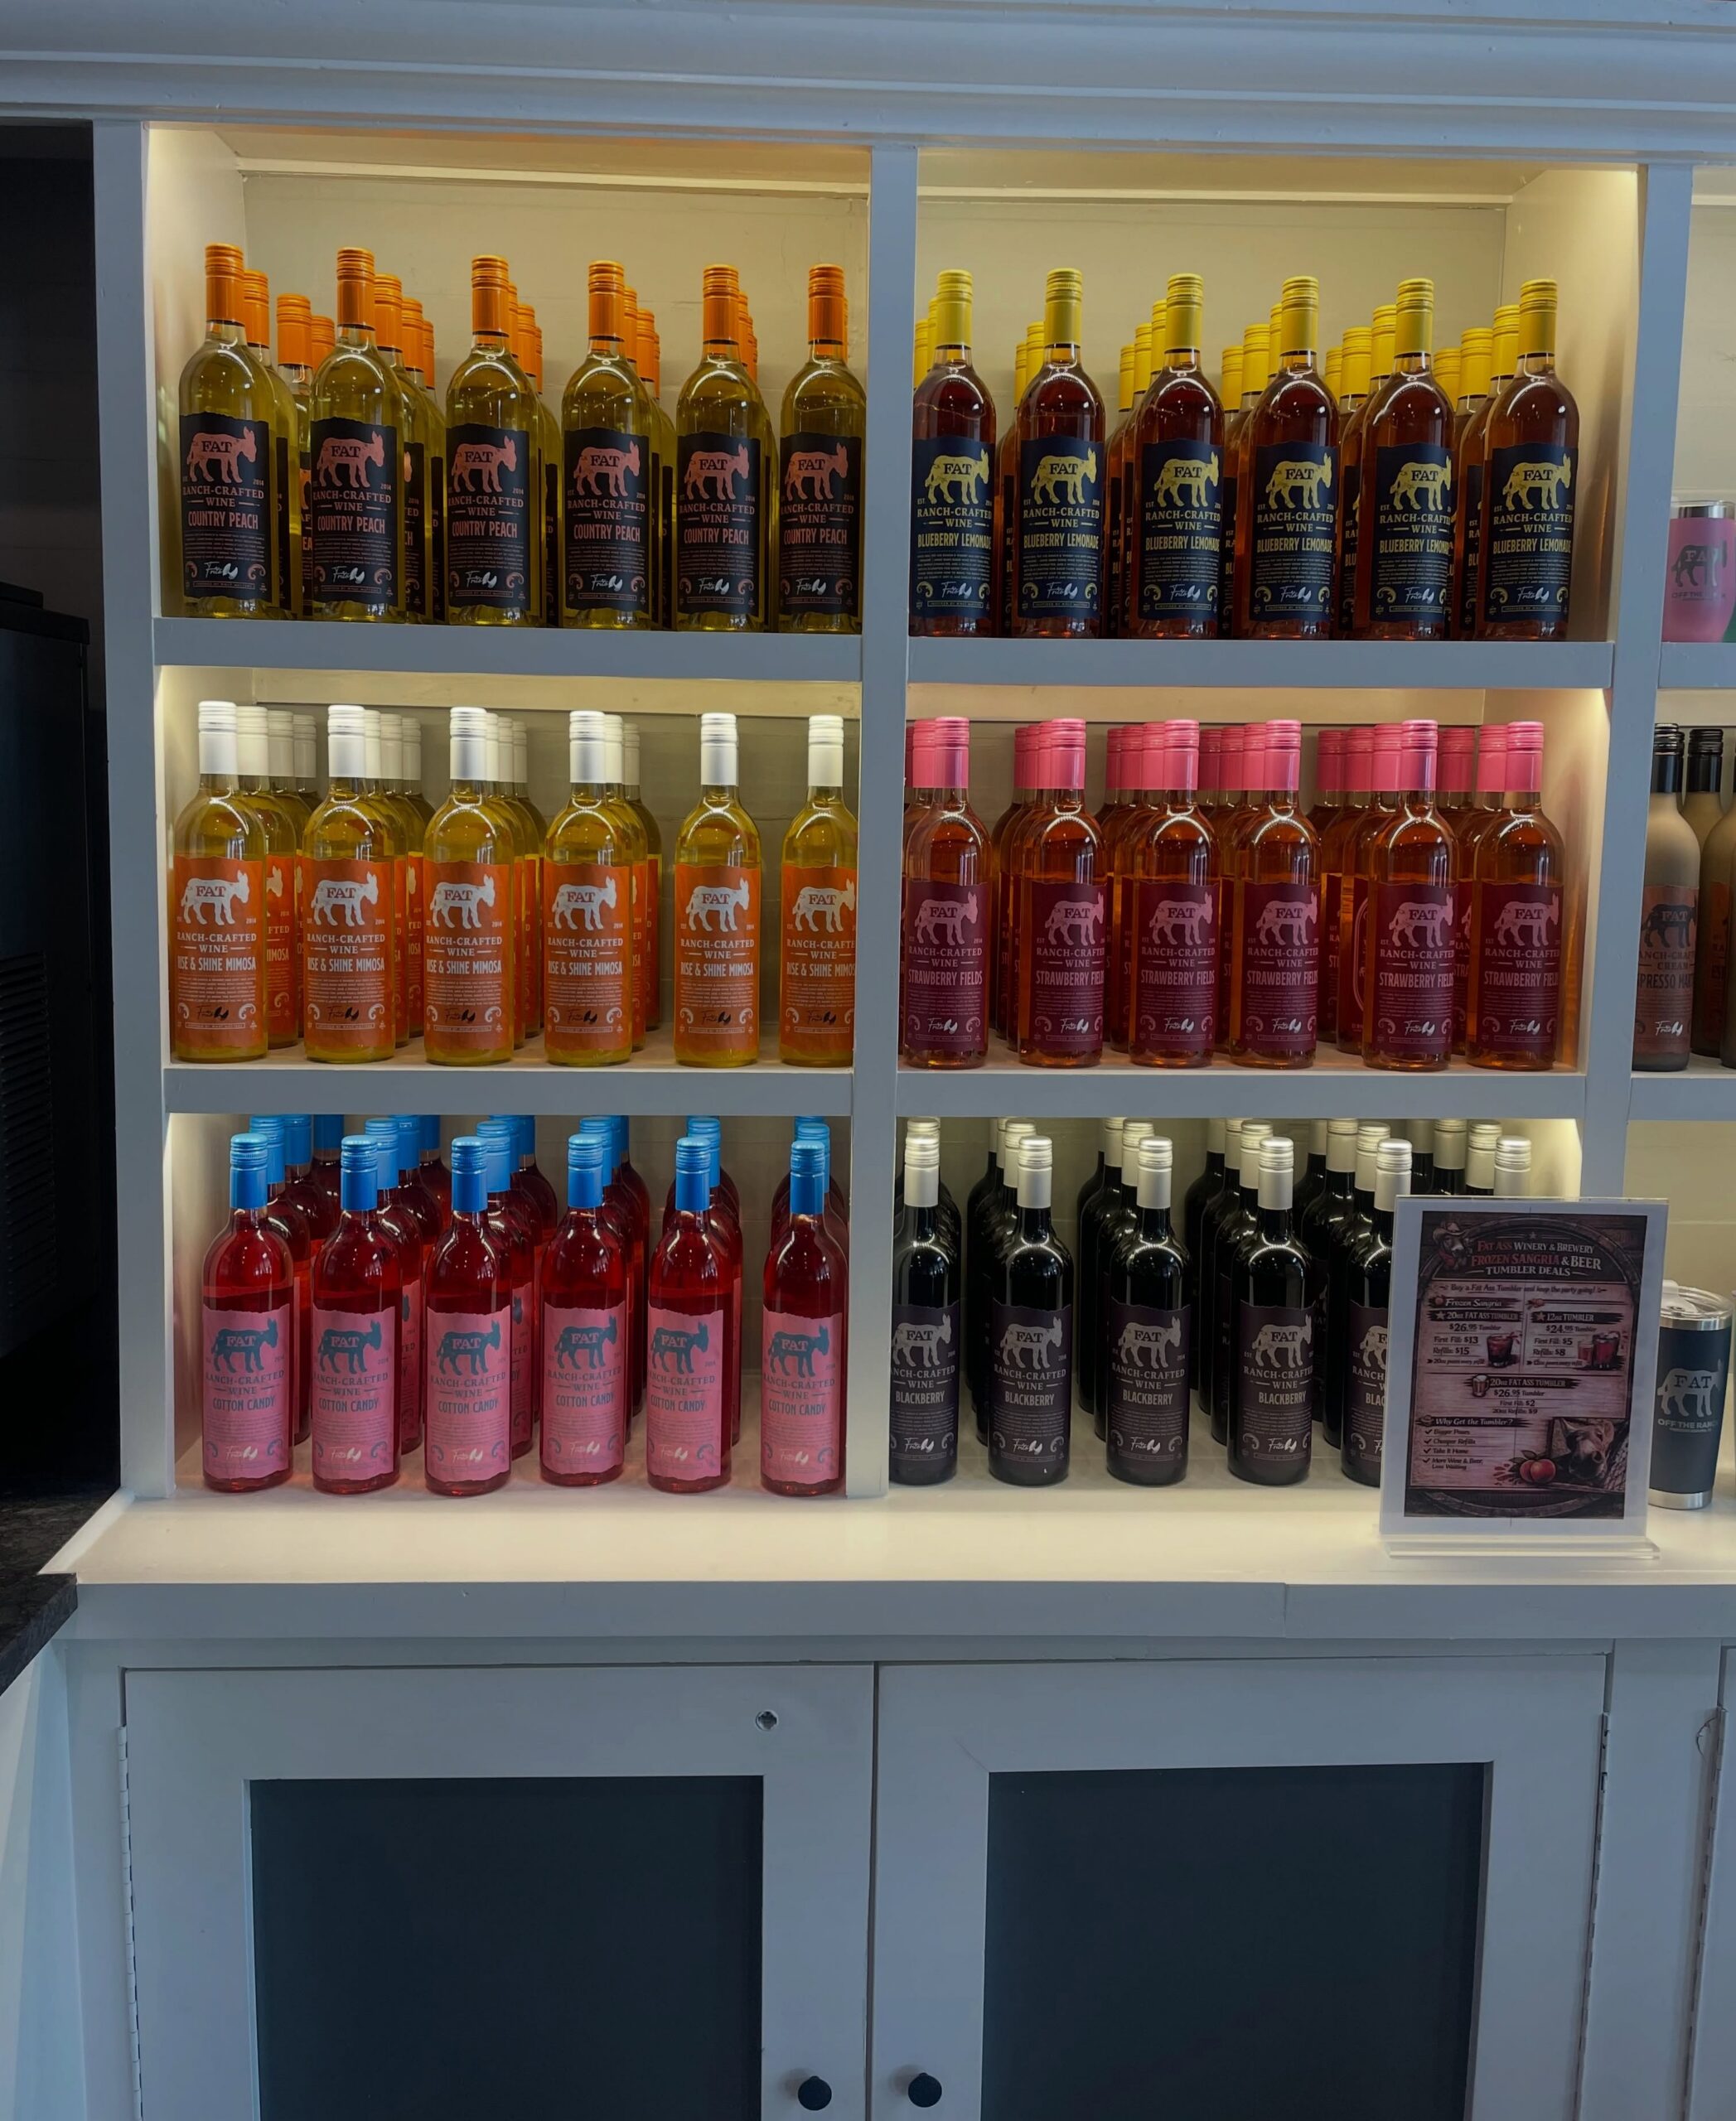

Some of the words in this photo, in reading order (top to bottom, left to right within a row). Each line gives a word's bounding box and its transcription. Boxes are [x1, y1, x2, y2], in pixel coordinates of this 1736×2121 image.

[202, 441, 232, 452] FAT
[331, 447, 360, 457] FAT
[591, 456, 620, 466] FAT
[699, 460, 728, 471] FAT
[944, 463, 971, 474] FAT
[1050, 463, 1078, 474] FAT
[1286, 468, 1314, 480] FAT
[1411, 470, 1439, 481] FAT
[335, 502, 363, 511] WINE
[917, 508, 992, 519] RANCH-CRAFTED
[1023, 507, 1100, 519] RANCH-CRAFTED
[1145, 511, 1221, 522] RANCH-CRAFTED
[1257, 511, 1333, 523] RANCH-CRAFTED
[1493, 513, 1572, 524] RANCH-CRAFTED
[188, 512, 225, 527] COUNTRY
[230, 513, 259, 529] PEACH
[701, 515, 729, 524] WINE
[1051, 519, 1078, 528] WINE
[452, 520, 486, 537] COUNTRY
[489, 521, 517, 539] PEACH
[574, 524, 612, 539] COUNTRY
[616, 525, 641, 542] PEACH
[1411, 524, 1437, 534] WINE
[784, 528, 816, 544] COUNTRY
[820, 529, 847, 544] PEACH
[918, 533, 959, 547] BLUEBERRY
[1023, 533, 1064, 548] BLUEBERRY
[1067, 534, 1099, 550] LEMONADE
[1145, 536, 1187, 550] BLUEBERRY
[1257, 538, 1299, 553] BLUEBERRY
[1302, 537, 1332, 553] LEMONADE
[1380, 540, 1423, 553] BLUEBERRY
[1492, 539, 1537, 554] BLUEBERRY
[1540, 539, 1571, 553] LEMONADE
[196, 886, 226, 896] FAT
[327, 887, 355, 898] FAT
[568, 891, 595, 902] FAT
[702, 893, 730, 904] FAT
[930, 907, 957, 918] FAT
[1064, 908, 1090, 919] FAT
[1275, 908, 1303, 919] FAT
[1410, 910, 1437, 920] FAT
[1662, 911, 1688, 921] FAT
[330, 945, 358, 954] WINE
[680, 940, 754, 948] RANCH-CRAFTED
[1142, 947, 1215, 957] RANCH-CRAFTED
[191, 958, 196, 969] &
[198, 958, 222, 971] SHINE
[225, 956, 256, 971] MIMOSA
[320, 959, 326, 970] &
[329, 959, 353, 971] SHINE
[356, 958, 384, 971] MIMOSA
[561, 962, 566, 974] &
[568, 962, 592, 975] SHINE
[595, 962, 622, 975] MIMOSA
[1065, 959, 1090, 968] WINE
[1410, 961, 1436, 969] WINE
[680, 962, 693, 975] RISE
[695, 964, 700, 975] &
[704, 963, 726, 977] SHINE
[729, 964, 753, 976] MIMOSA
[908, 969, 956, 985] STRAWBERRY
[960, 969, 982, 985] FIELDS
[1036, 972, 1088, 986] STRAWBERRY
[1141, 969, 1193, 985] STRAWBERRY
[1197, 969, 1215, 984] FIELDS
[1247, 970, 1300, 985] STRAWBERRY
[1380, 973, 1435, 988] STRAWBERRY
[1484, 971, 1540, 987] STRAWBERRY
[1561, 1257, 1569, 1265] &
[1571, 1256, 1601, 1270] BEER
[1486, 1266, 1536, 1274] TUMBLER
[1539, 1267, 1570, 1276] DEALS
[1473, 1299, 1501, 1309] Sangria
[226, 1336, 257, 1346] FAT
[570, 1332, 600, 1344] FAT
[907, 1330, 933, 1341] FAT
[1134, 1331, 1161, 1342] FAT
[1271, 1331, 1298, 1342] FAT
[452, 1338, 481, 1349] FAT
[781, 1339, 809, 1351] FAT
[1273, 1380, 1298, 1389] WINE
[1674, 1375, 1711, 1388] FAT
[556, 1394, 587, 1407] COTTON
[591, 1392, 615, 1405] CANDY
[650, 1394, 675, 1410] COTTON
[678, 1399, 704, 1411] CANDY
[896, 1390, 945, 1404] BLACKBERRY
[1005, 1391, 1054, 1405] BLACKBERRY
[1123, 1389, 1173, 1405] BLACKBERRY
[1259, 1391, 1307, 1404] BLACKBERRY
[213, 1399, 244, 1411] COTTON
[247, 1396, 274, 1410] CANDY
[319, 1399, 347, 1412] COTTON
[351, 1398, 379, 1412] CANDY
[1658, 1418, 1676, 1427] OFF
